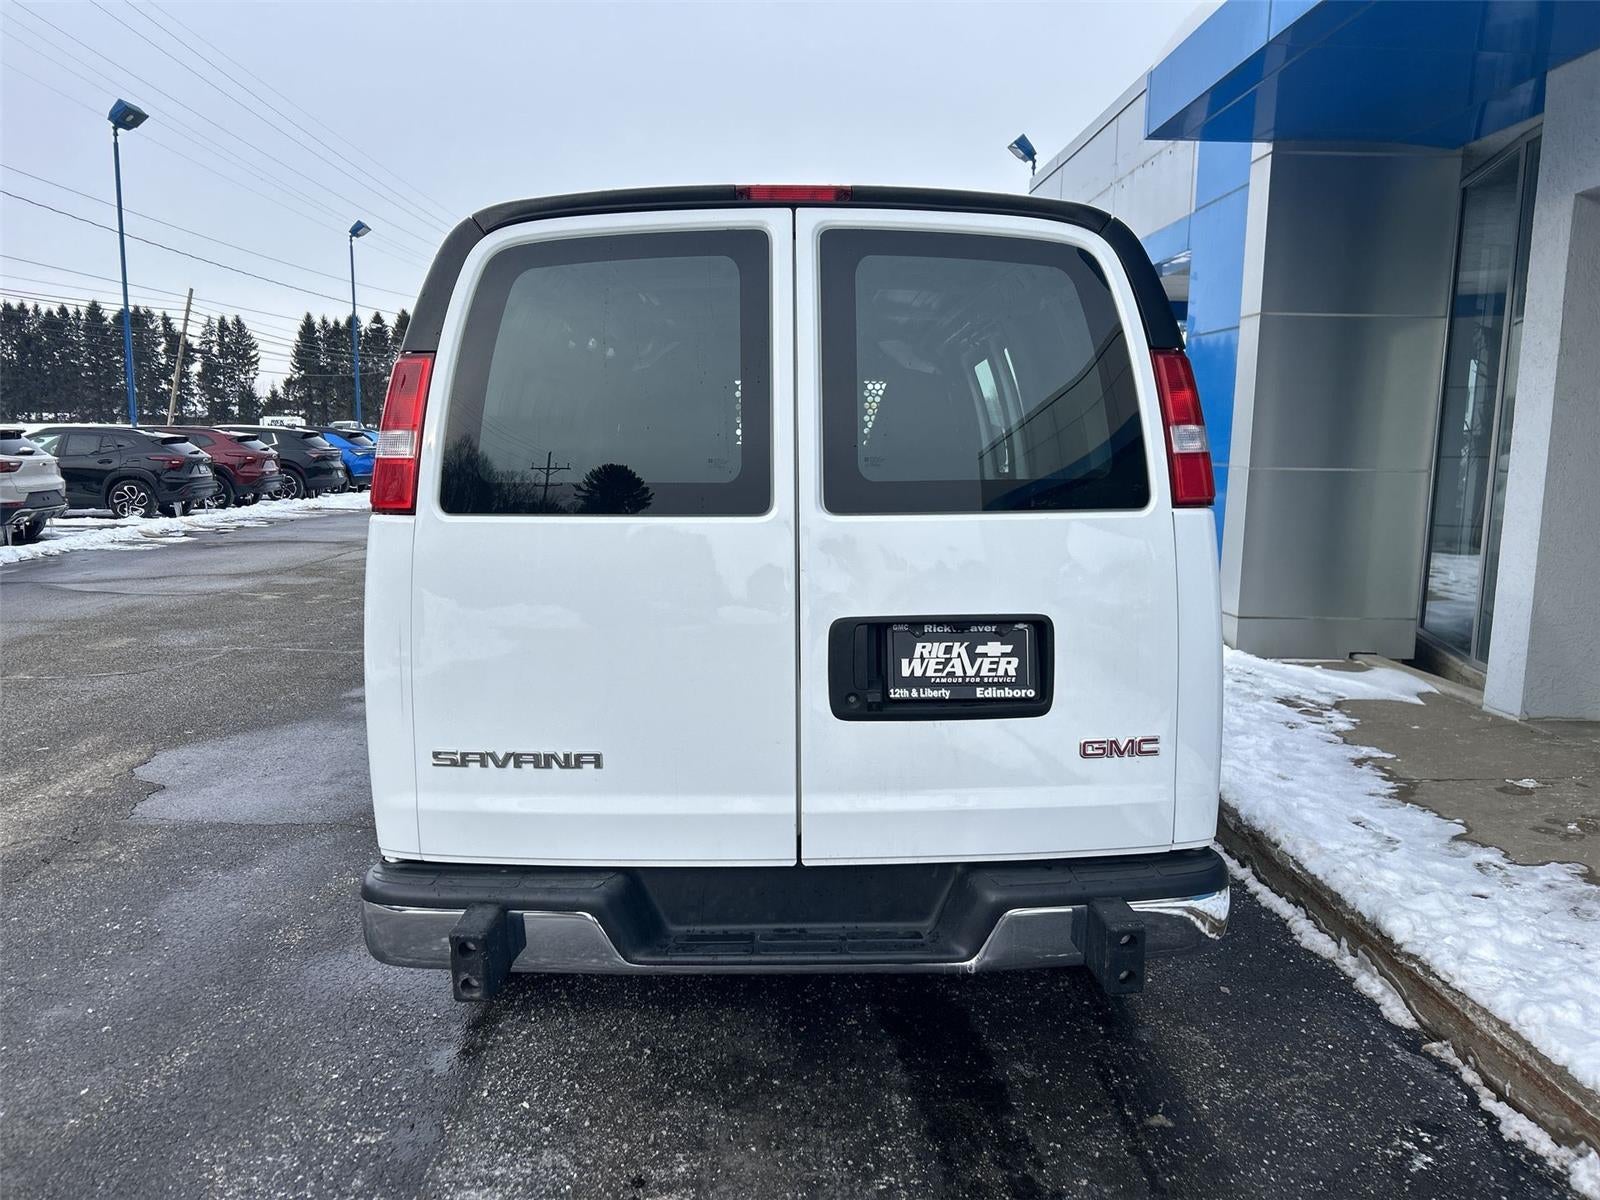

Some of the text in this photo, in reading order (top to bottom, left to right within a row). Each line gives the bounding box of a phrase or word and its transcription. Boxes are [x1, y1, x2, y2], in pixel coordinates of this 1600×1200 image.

[923, 624, 997, 633] Rick aver
[913, 642, 970, 658] RICK
[901, 657, 1019, 677] WEAVER
[889, 688, 951, 699] 12th & Liberty
[976, 687, 1035, 698] Edinboro
[1079, 736, 1160, 759] GMC
[432, 750, 603, 769] SAVANA
